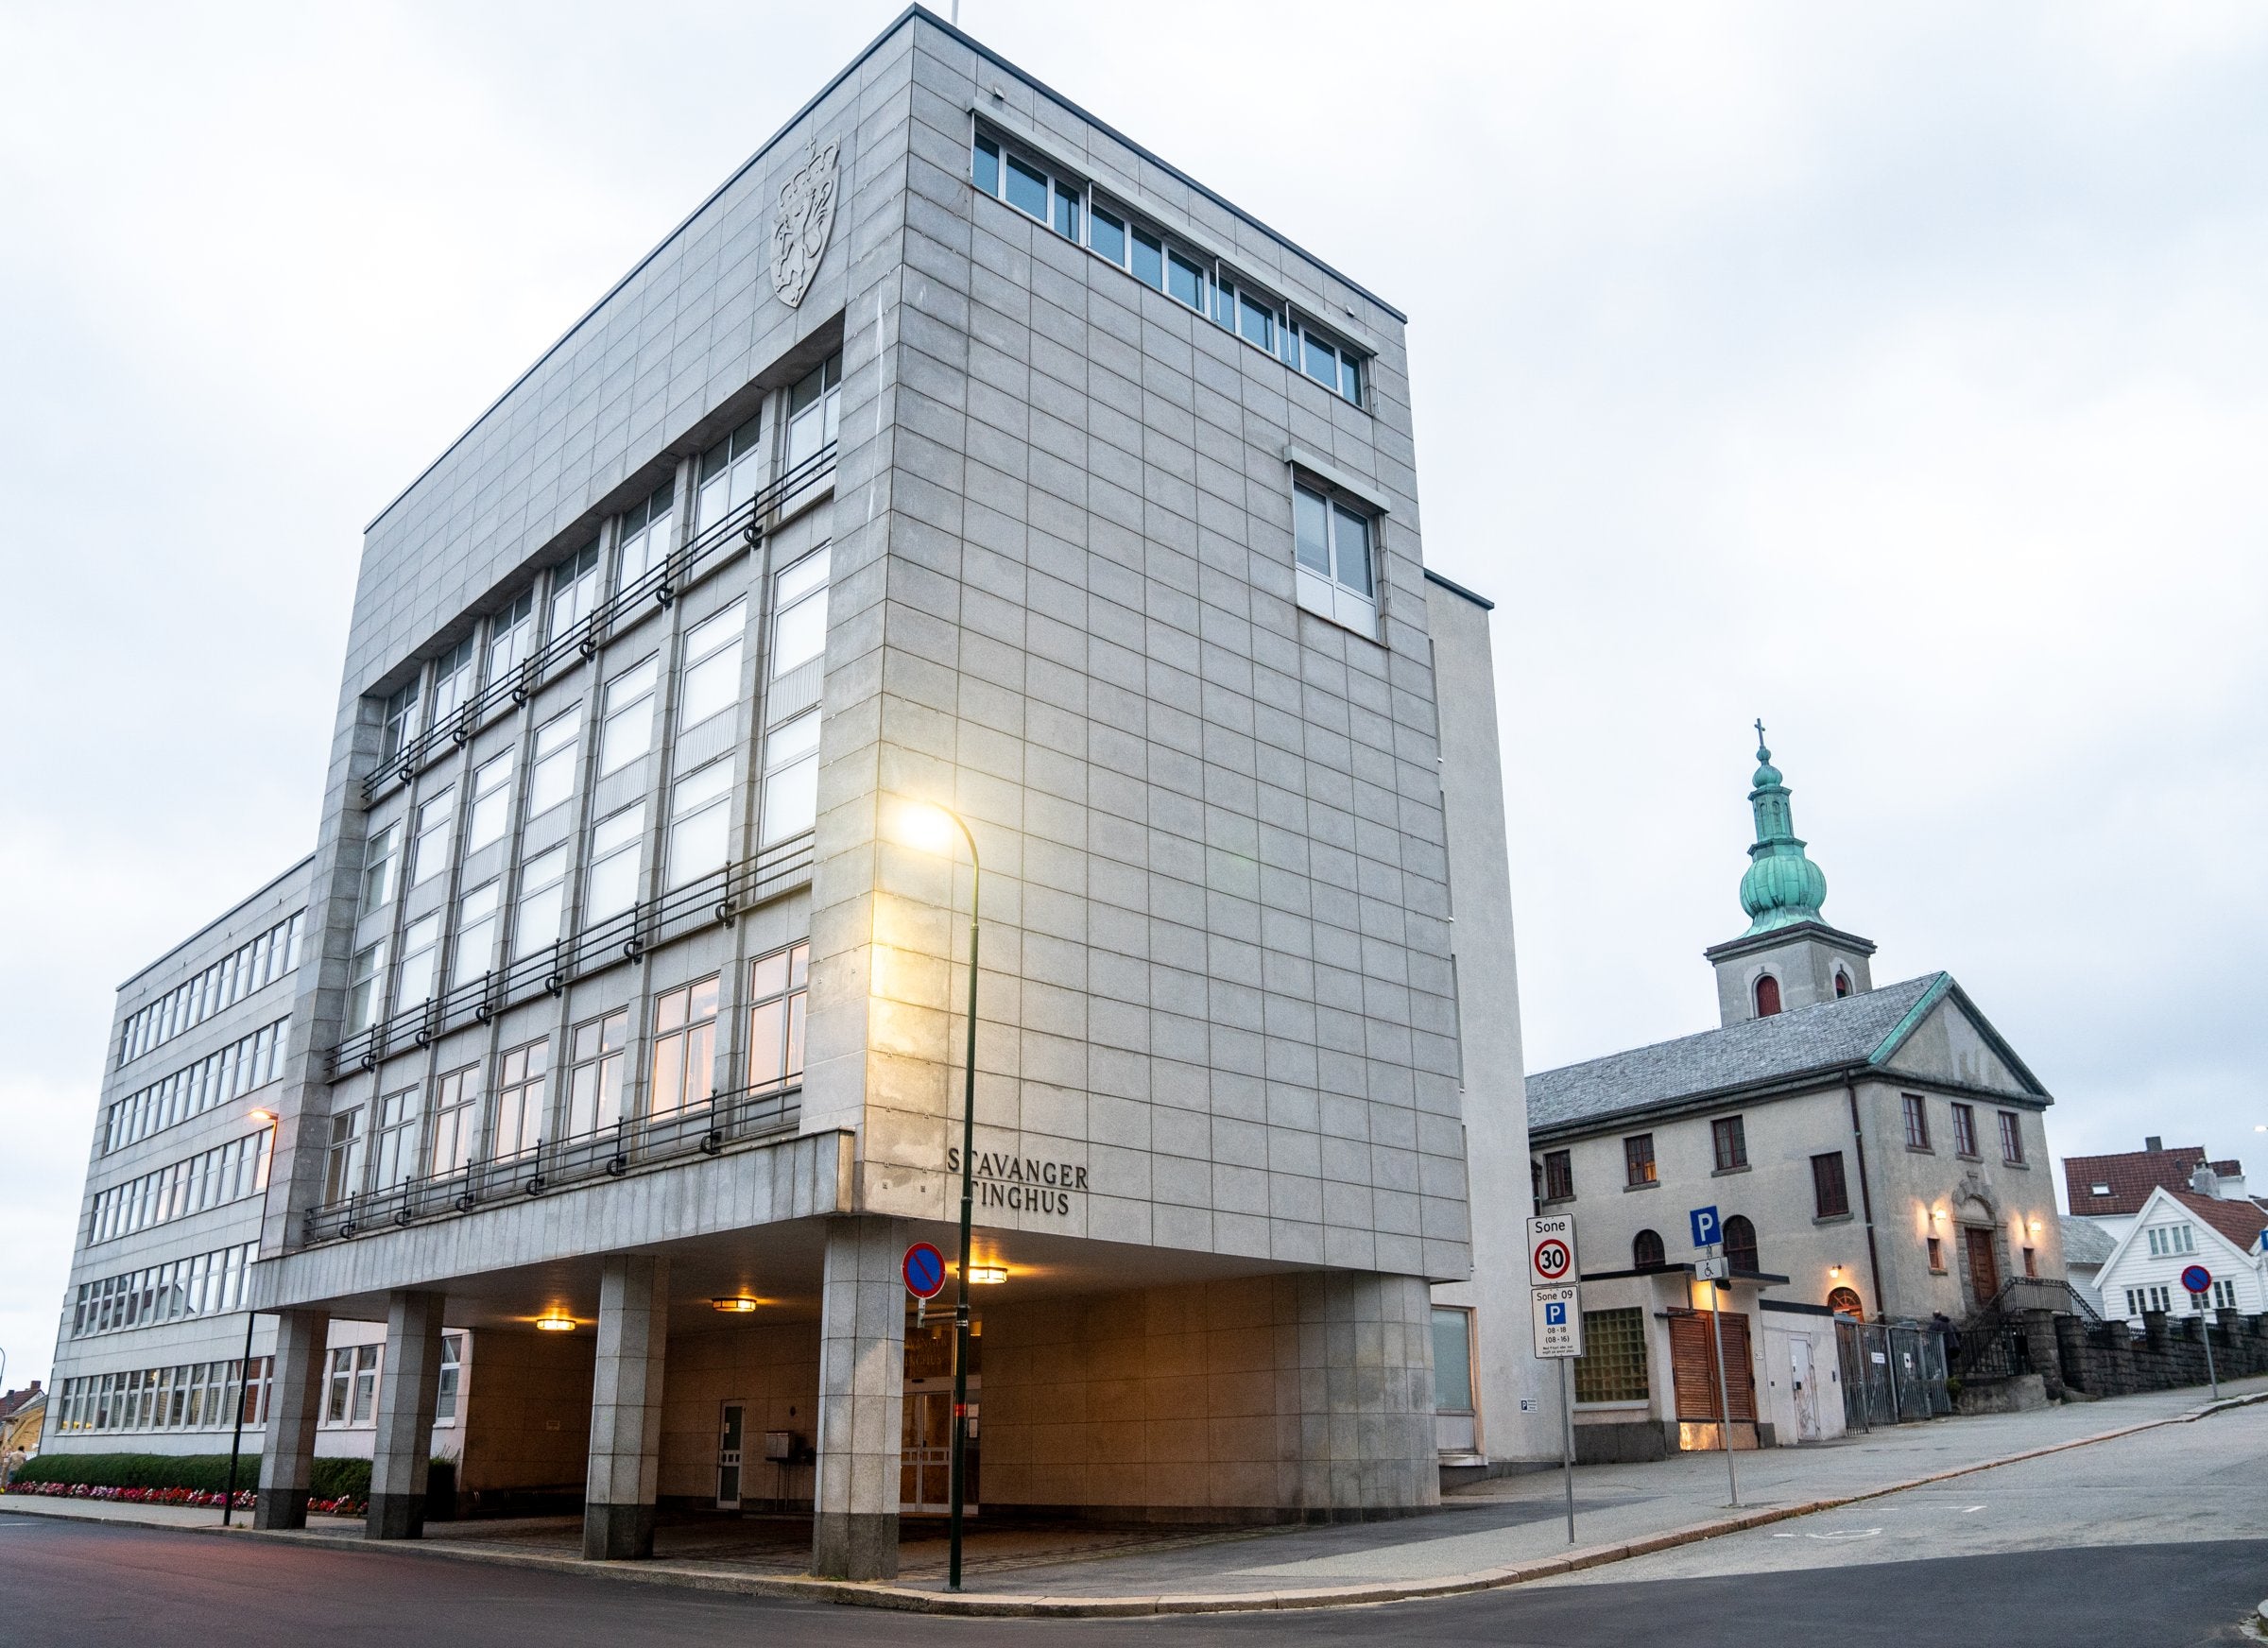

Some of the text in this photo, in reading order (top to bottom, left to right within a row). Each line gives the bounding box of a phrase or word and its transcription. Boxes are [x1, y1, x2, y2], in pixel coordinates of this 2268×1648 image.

[1535, 1221, 1566, 1233] Sone
[1697, 1212, 1713, 1242] P
[1541, 1248, 1564, 1269] 30
[1537, 1290, 1573, 1301] Sone 09
